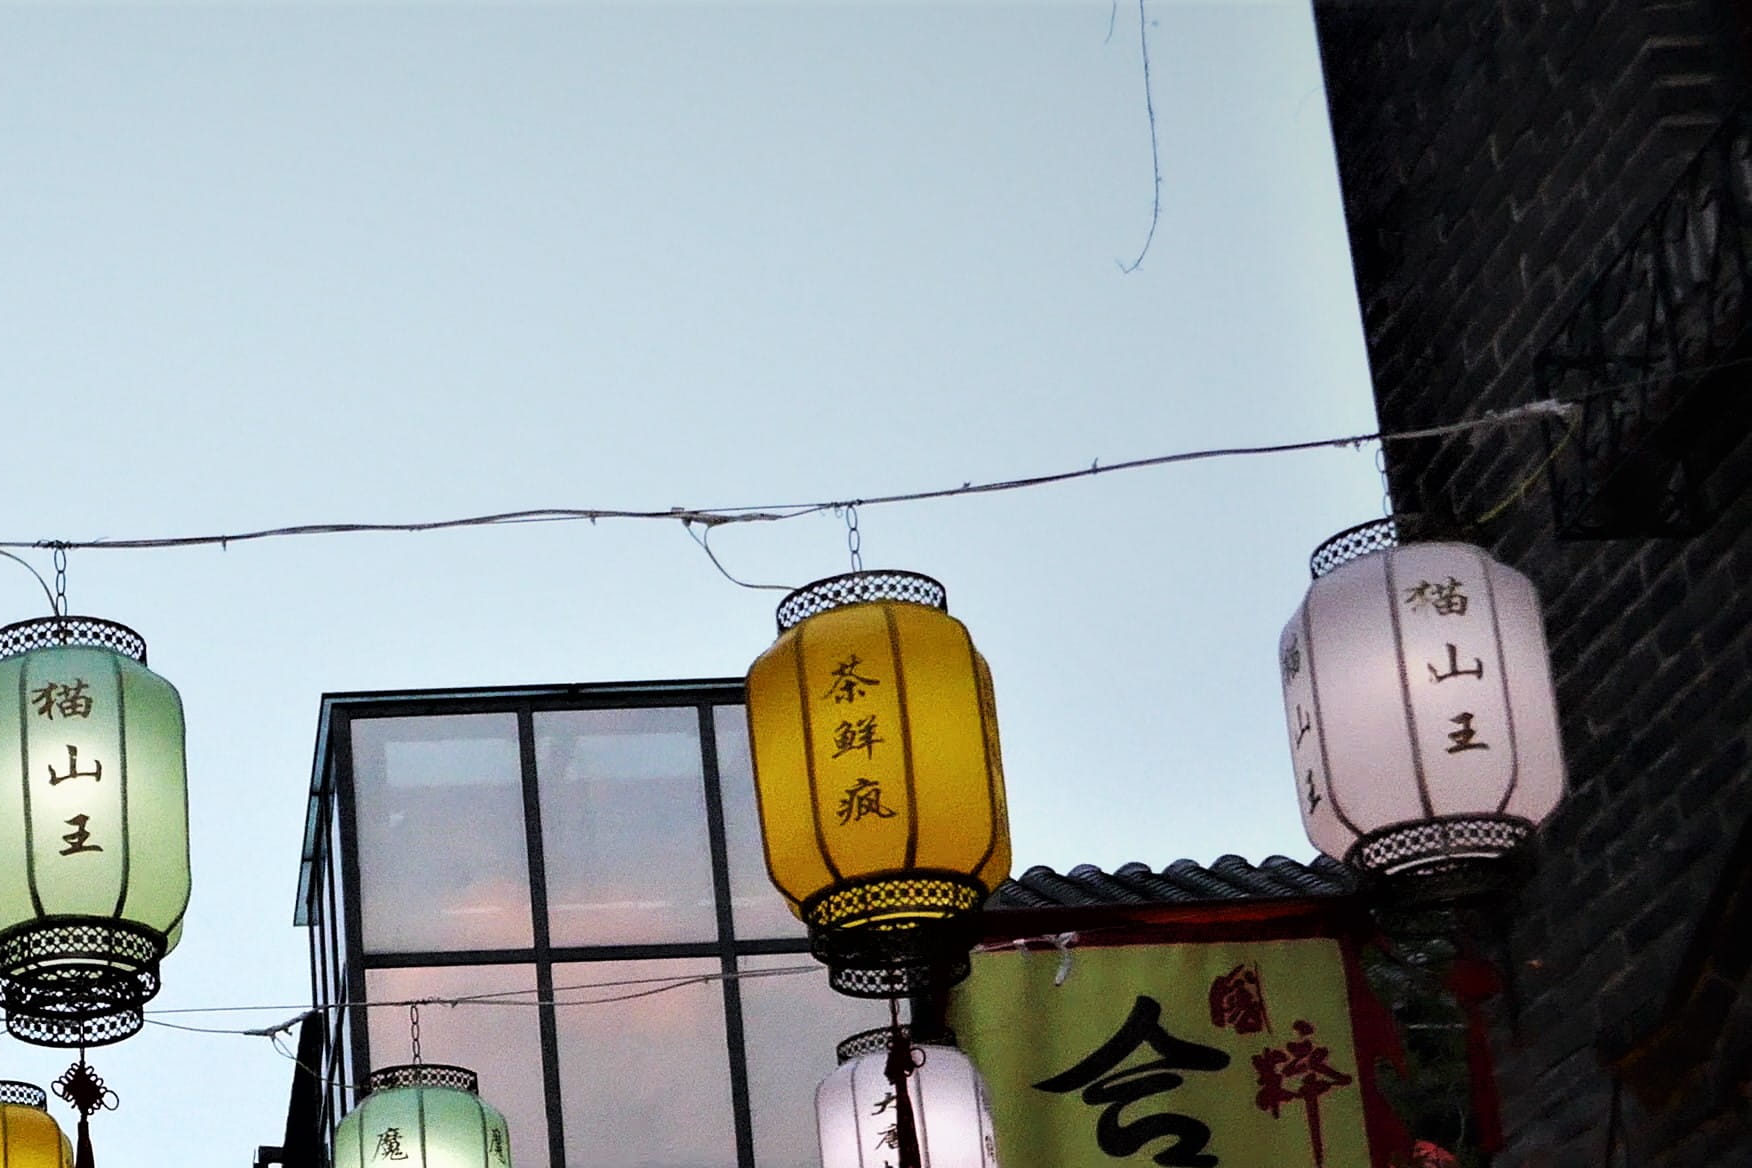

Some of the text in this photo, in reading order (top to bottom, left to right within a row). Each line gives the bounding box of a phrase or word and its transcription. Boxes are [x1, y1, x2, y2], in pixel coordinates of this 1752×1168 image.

[821, 654, 897, 827] 茶鲜疯
[1404, 576, 1490, 754] 猫山王
[31, 678, 104, 856] 猫山王
